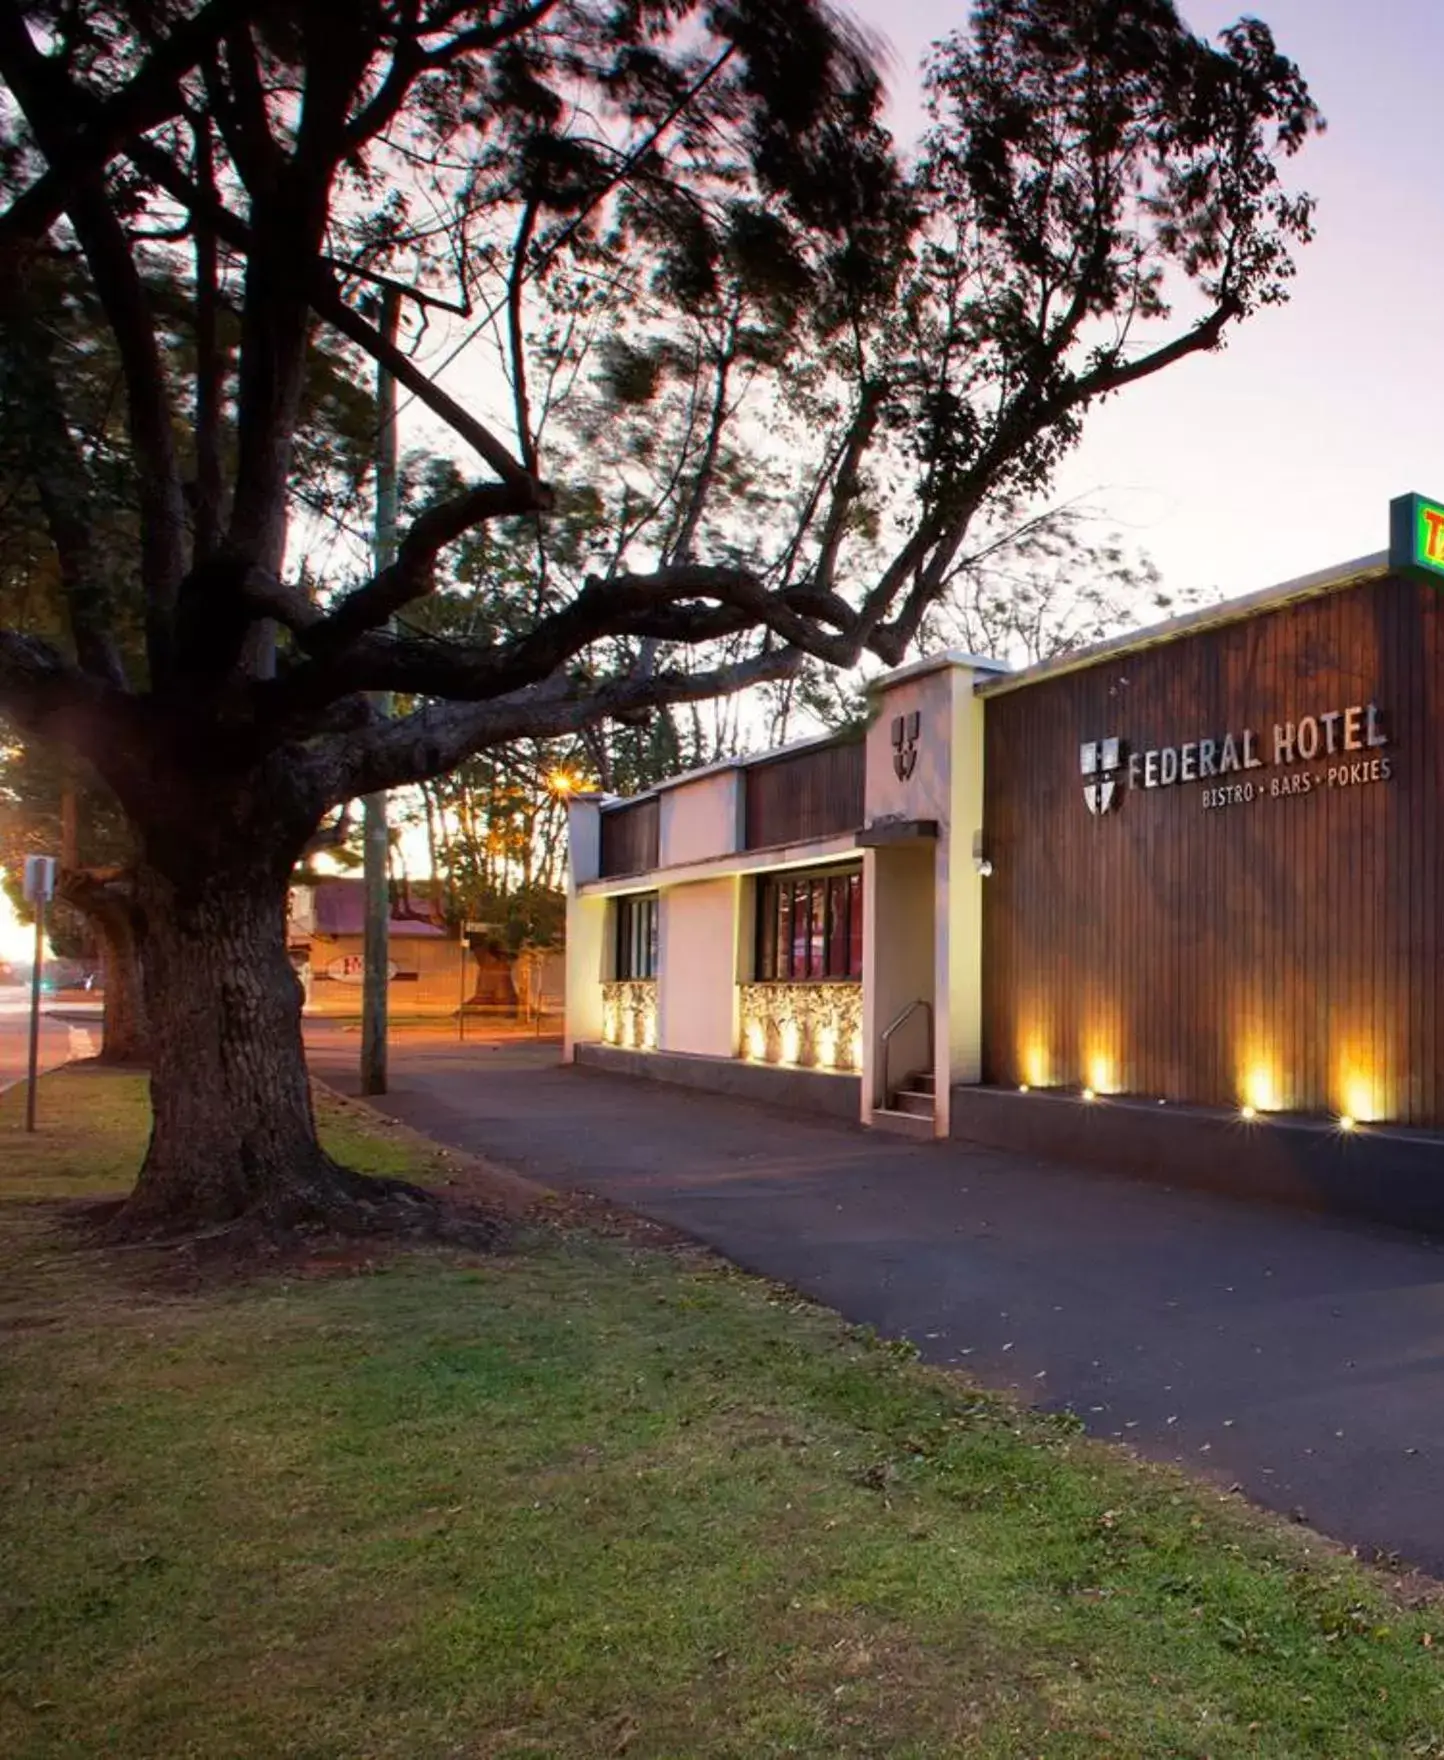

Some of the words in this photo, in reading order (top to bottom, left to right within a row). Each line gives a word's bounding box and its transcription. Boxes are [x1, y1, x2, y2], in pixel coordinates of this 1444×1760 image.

[1128, 729, 1263, 789] FEDERAL
[1274, 703, 1387, 765] HOTEL
[1202, 782, 1254, 809] BISTRO
[1270, 772, 1311, 797] BARS
[1327, 757, 1392, 788] POKIES
